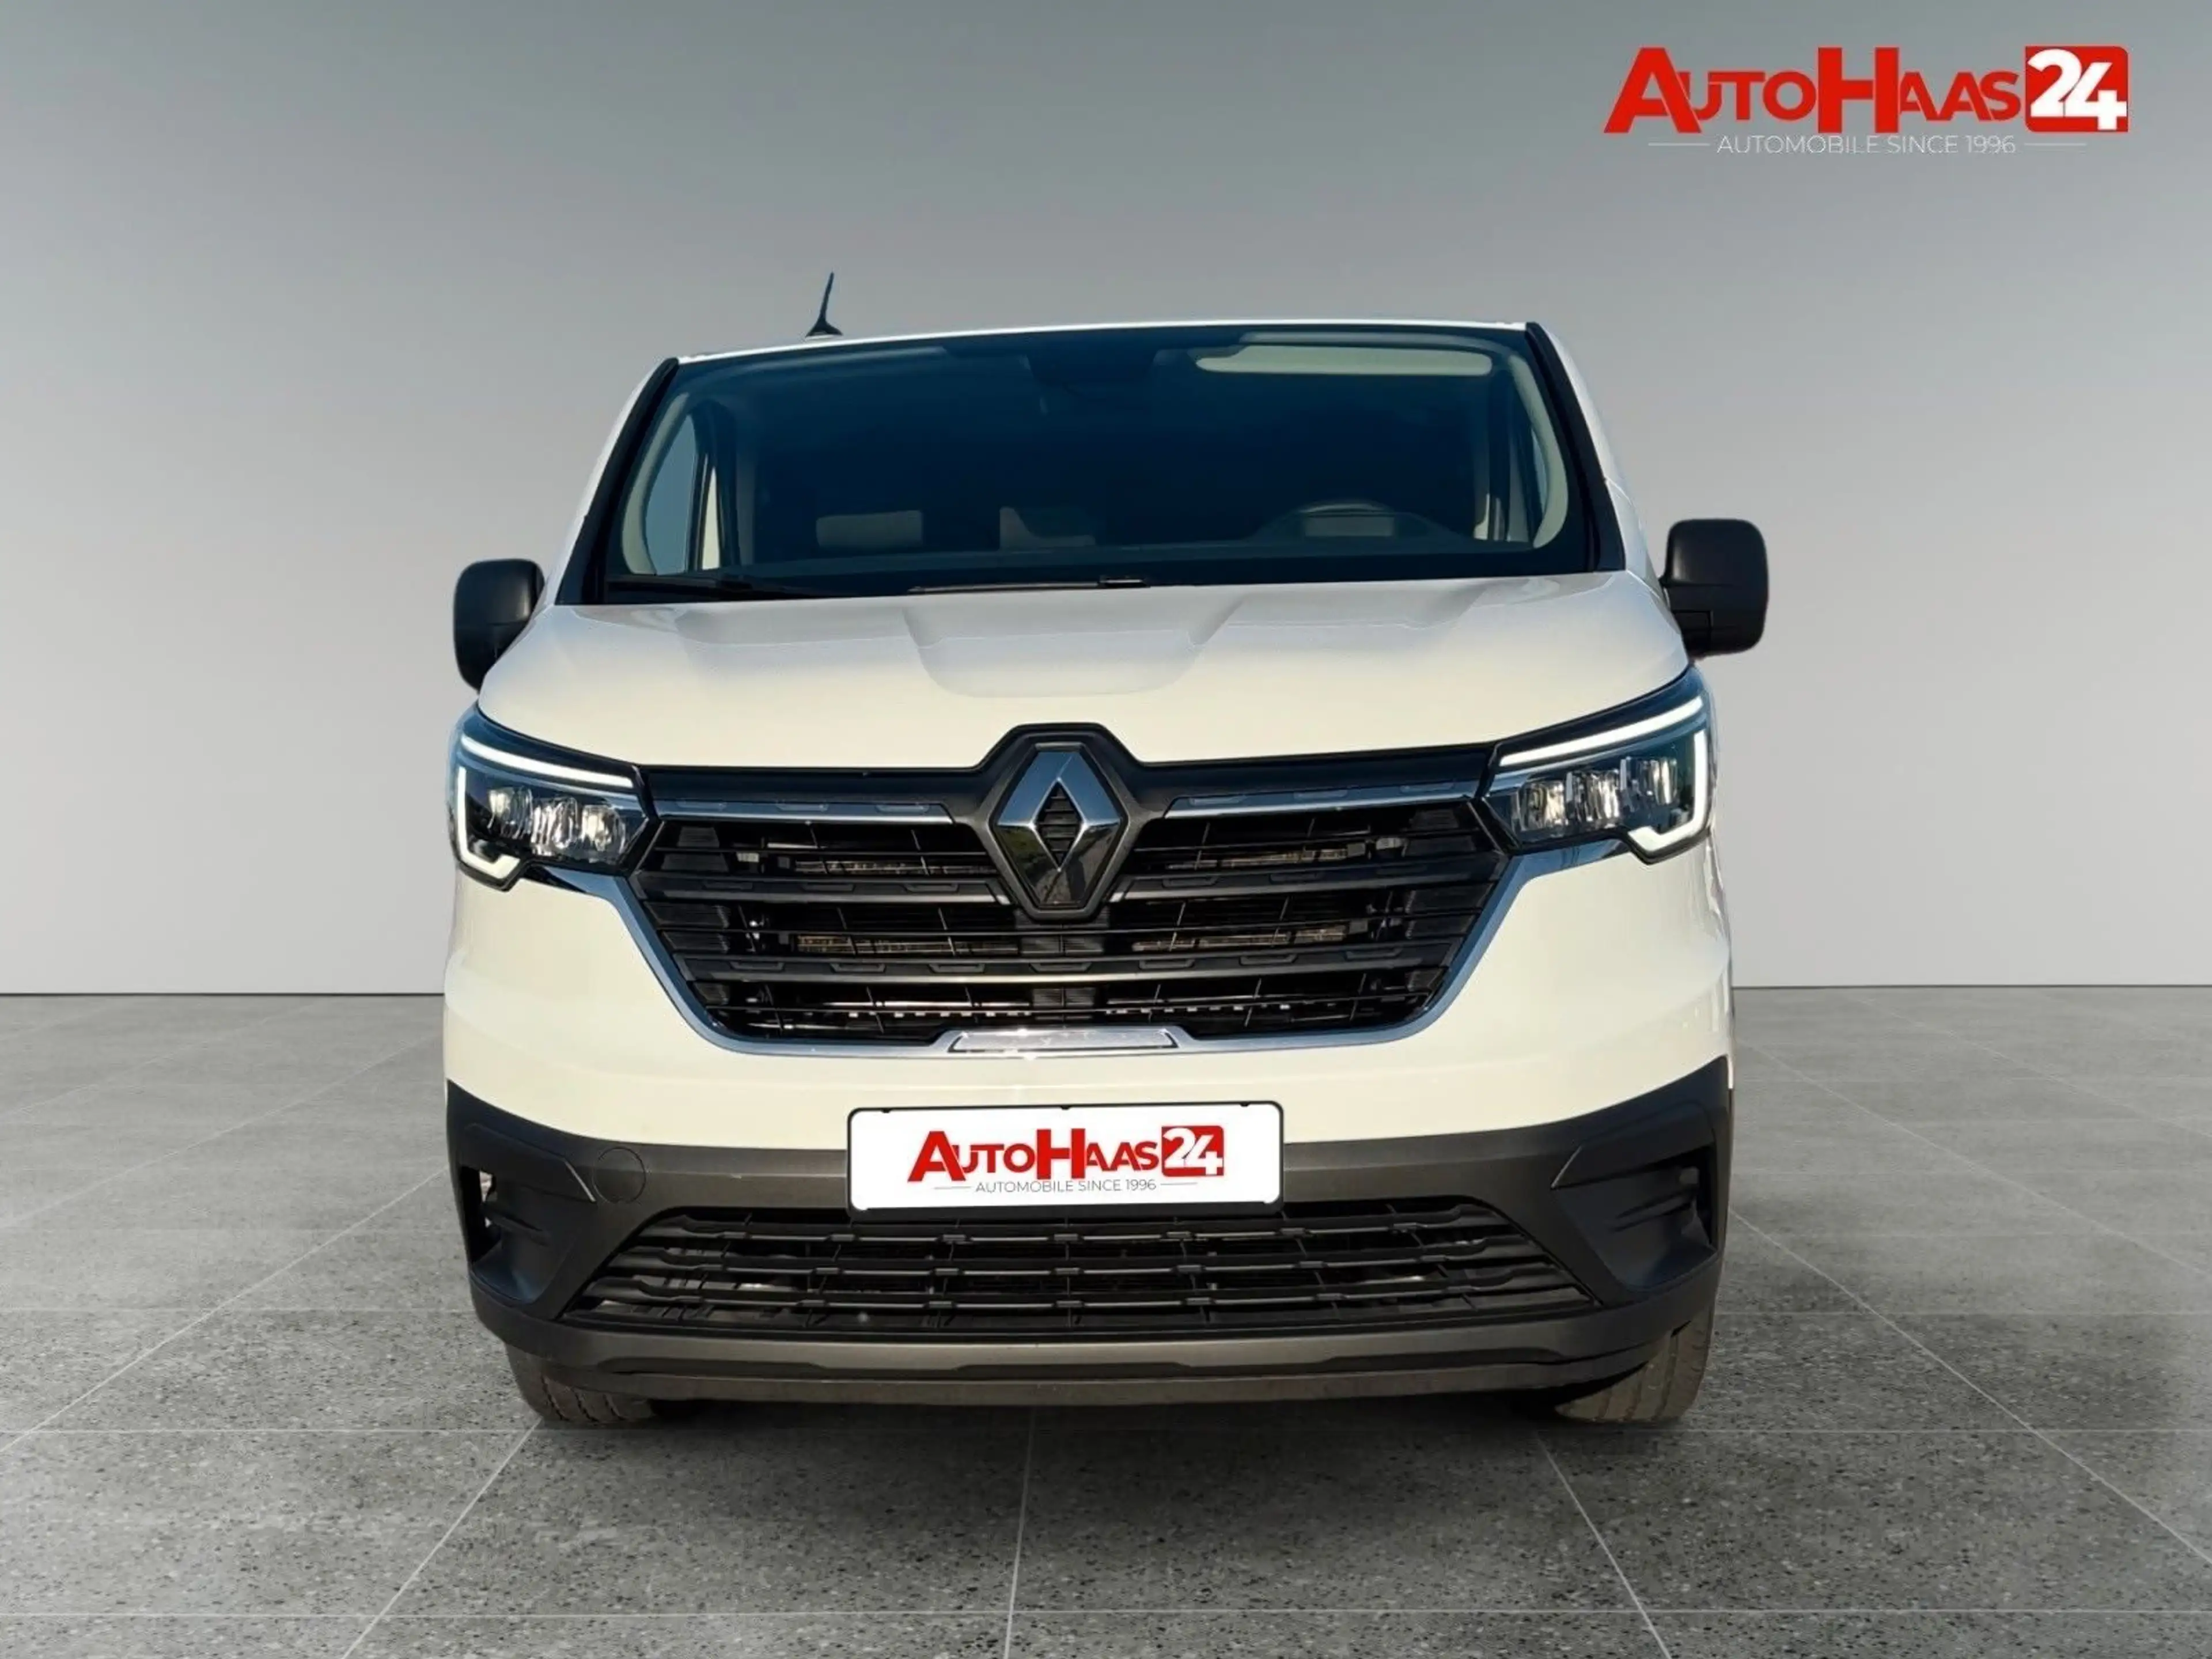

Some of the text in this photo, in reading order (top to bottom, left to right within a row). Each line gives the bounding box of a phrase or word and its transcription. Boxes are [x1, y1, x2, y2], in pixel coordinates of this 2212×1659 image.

[975, 1178, 1157, 1194] AUTOMOBILE SINCE 1996
